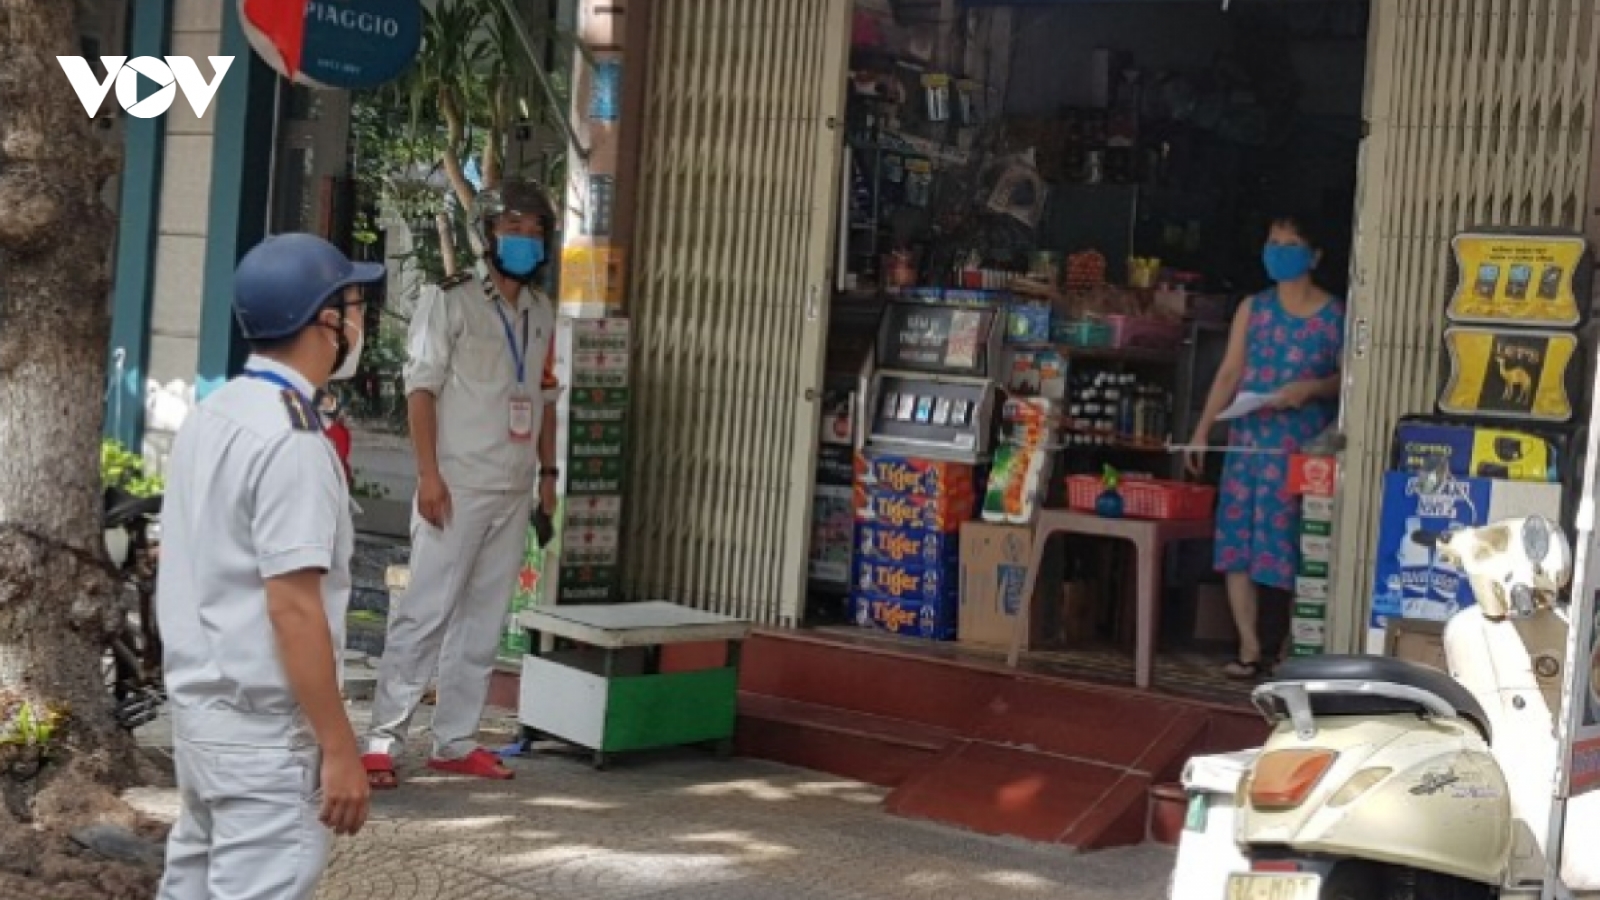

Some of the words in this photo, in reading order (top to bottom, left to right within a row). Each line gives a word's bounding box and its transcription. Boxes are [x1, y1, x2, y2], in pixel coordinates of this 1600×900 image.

[303, 2, 398, 38] PIAGGIO
[877, 462, 923, 491] Tiger
[877, 497, 922, 526] Tiger
[876, 531, 922, 560] Tiger
[875, 566, 921, 595] Tiger
[871, 601, 918, 632] Tiger
